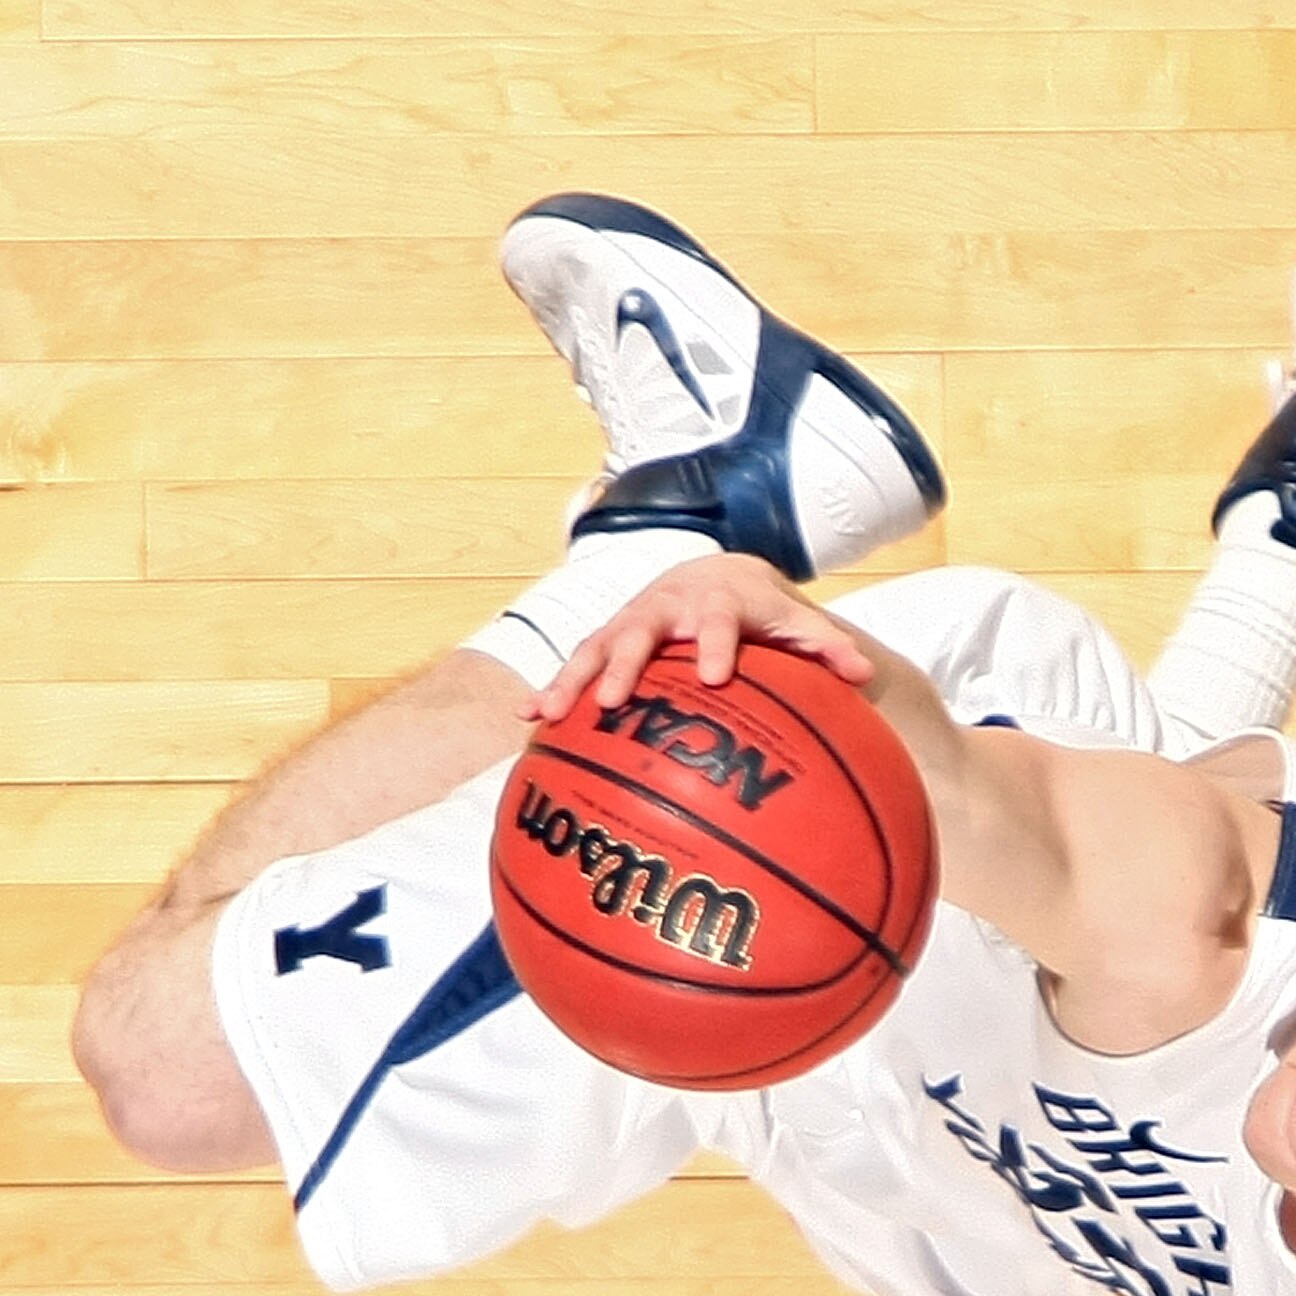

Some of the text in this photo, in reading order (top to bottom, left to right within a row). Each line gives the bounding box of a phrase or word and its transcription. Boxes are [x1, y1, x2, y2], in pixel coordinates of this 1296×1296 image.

[593, 694, 795, 812] NCAA
[274, 881, 393, 977] Y
[515, 779, 762, 972] Wilson
